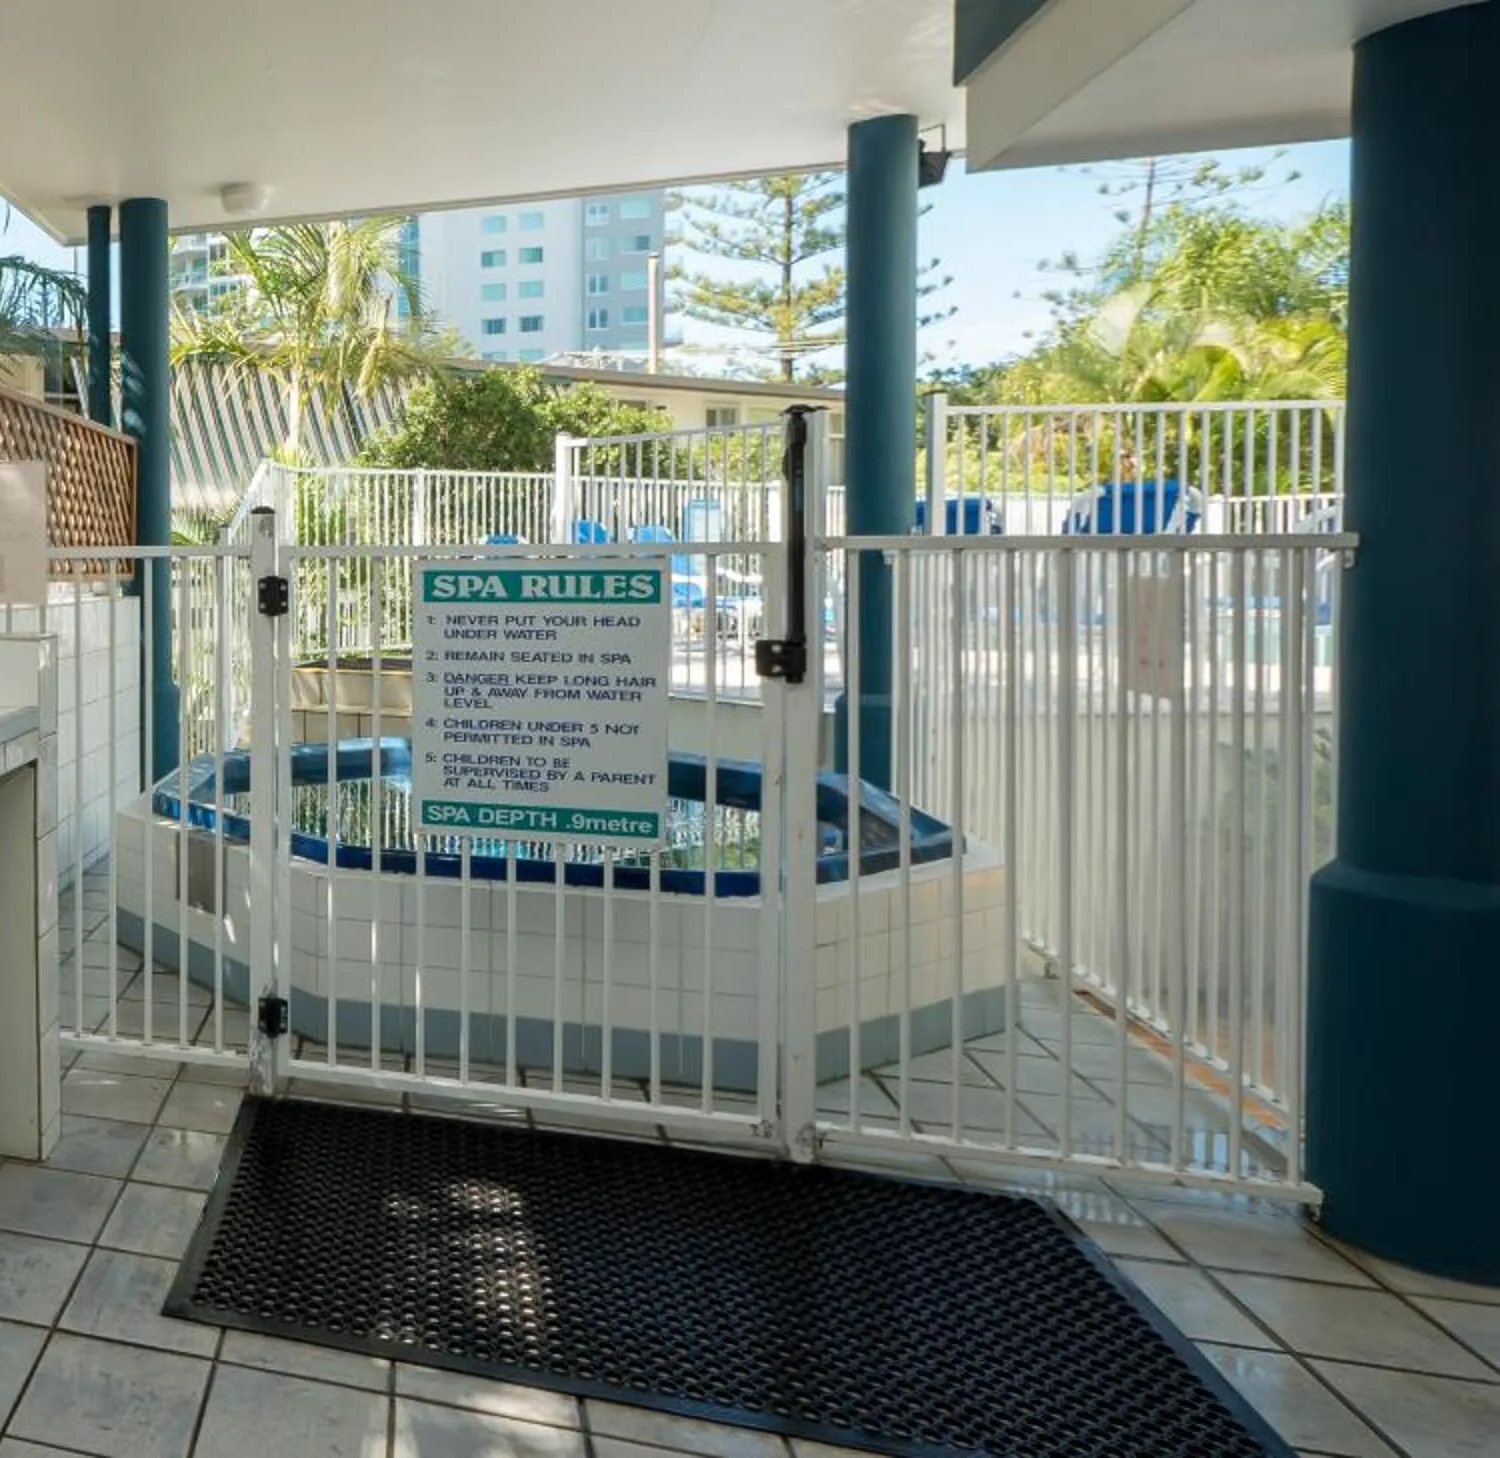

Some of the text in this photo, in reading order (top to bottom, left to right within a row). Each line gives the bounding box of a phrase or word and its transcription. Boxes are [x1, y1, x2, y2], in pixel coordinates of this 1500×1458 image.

[431, 575, 654, 599] SPA RULES
[446, 615, 499, 626] NEVER
[505, 616, 536, 626] PUT
[542, 616, 587, 627] YOUR
[593, 616, 641, 627] HEAD
[444, 629, 557, 641] UNDER WATER
[445, 651, 505, 662] REMAIN
[510, 652, 573, 664] SEATED
[579, 653, 594, 664] IN
[600, 653, 631, 665] SPA
[443, 673, 508, 685] DANGER
[515, 674, 558, 685] KEEP
[564, 675, 609, 686] LONG
[616, 676, 657, 687] HAIR
[444, 687, 642, 702] UP & AWAY FROM WATER
[443, 698, 492, 709] LEVEL
[443, 719, 521, 732] CHILDREN
[528, 721, 583, 733] UNDER
[590, 724, 599, 734] 5
[605, 724, 639, 735] NOT
[443, 731, 591, 748] PERMITTED IN SPA
[443, 754, 521, 766] CHILDREN
[527, 756, 547, 767] TO
[553, 758, 570, 768] BE
[443, 766, 656, 785] SUPERVISED BY A PARENT
[443, 777, 550, 792] AT ALL TIMES
[427, 804, 653, 834] SPA DEPTH .9metre
